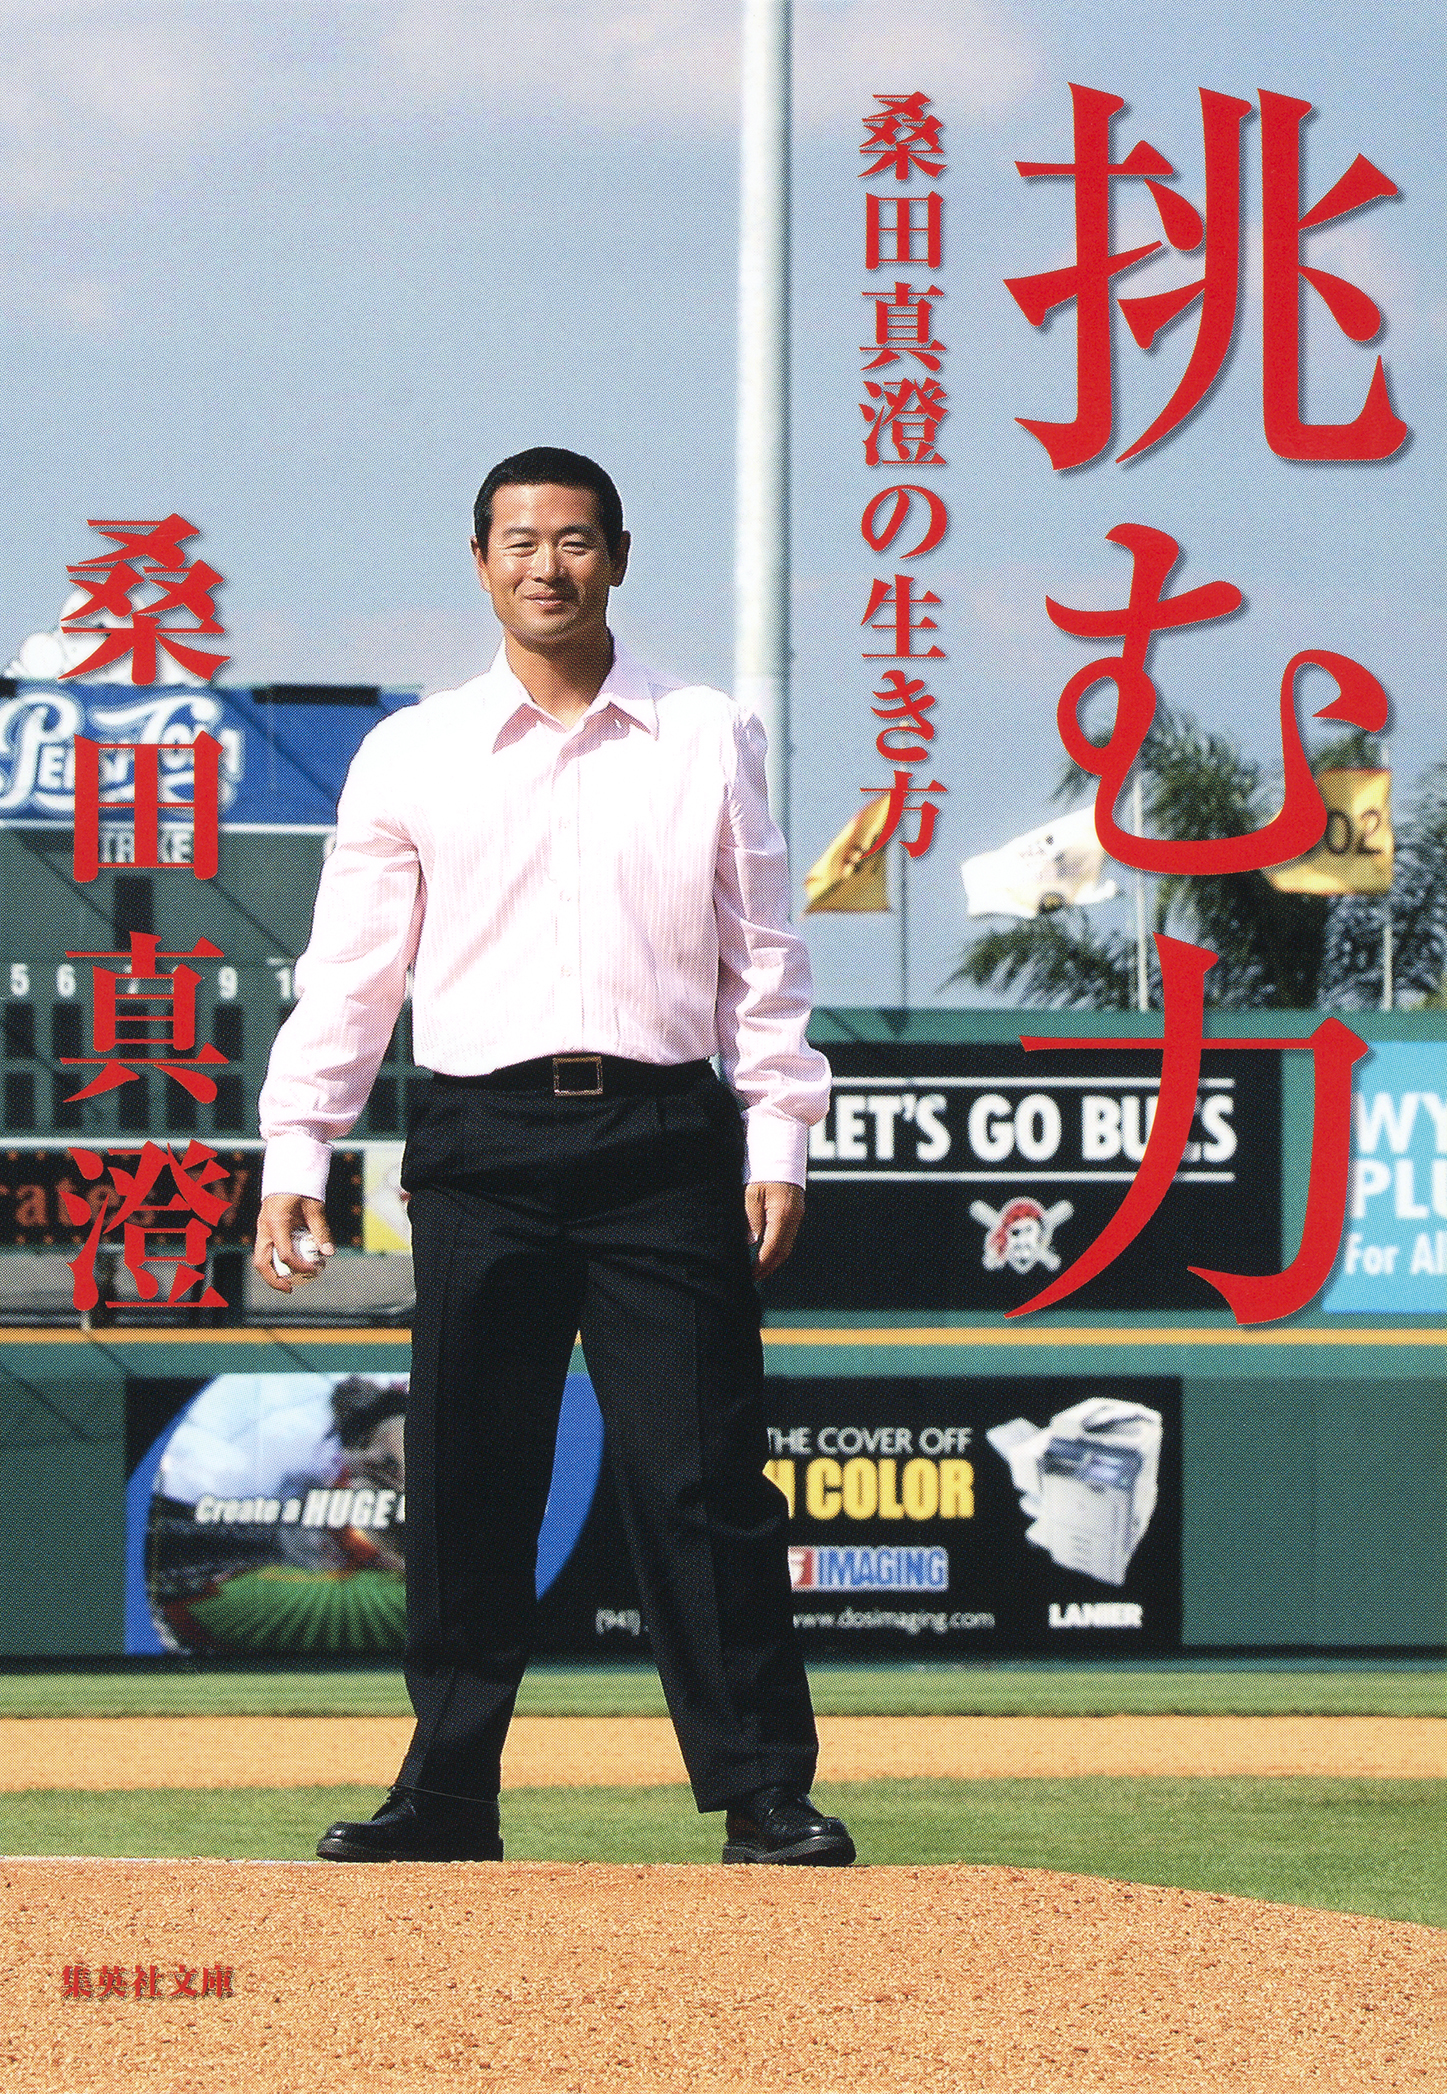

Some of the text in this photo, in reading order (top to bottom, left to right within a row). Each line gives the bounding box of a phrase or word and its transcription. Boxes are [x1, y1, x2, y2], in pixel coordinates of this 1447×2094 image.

[10, 963, 30, 996] 5
[56, 964, 76, 998] 6
[217, 966, 238, 999] 9
[968, 1093, 1062, 1162] GO
[1081, 1094, 1238, 1162] BUS
[817, 1427, 913, 1454] COVER
[918, 1427, 972, 1454] OFF
[301, 1488, 397, 1528] HUGE
[806, 1457, 975, 1521] COLOR
[817, 1549, 946, 1586] IMAGING
